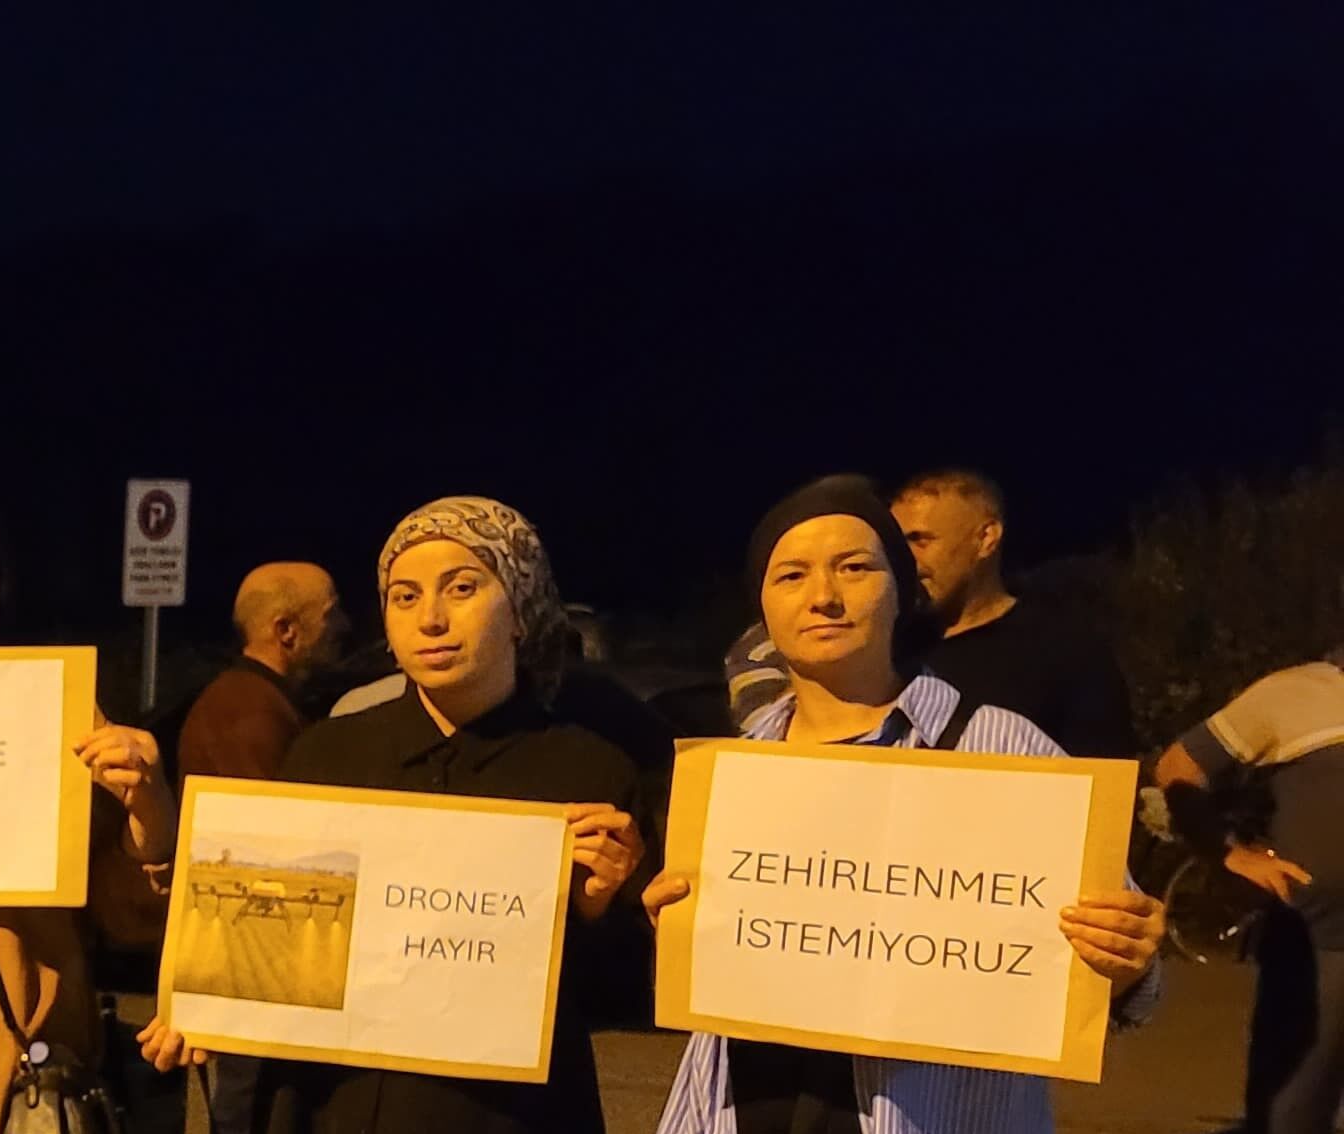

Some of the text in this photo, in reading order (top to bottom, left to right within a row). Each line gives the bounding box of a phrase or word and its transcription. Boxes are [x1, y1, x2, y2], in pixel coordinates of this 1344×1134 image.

[727, 849, 1047, 910] ZEHİRLENMEK
[403, 935, 495, 964] HAYIR
[736, 909, 1034, 977] İSTEMİYORUZ
